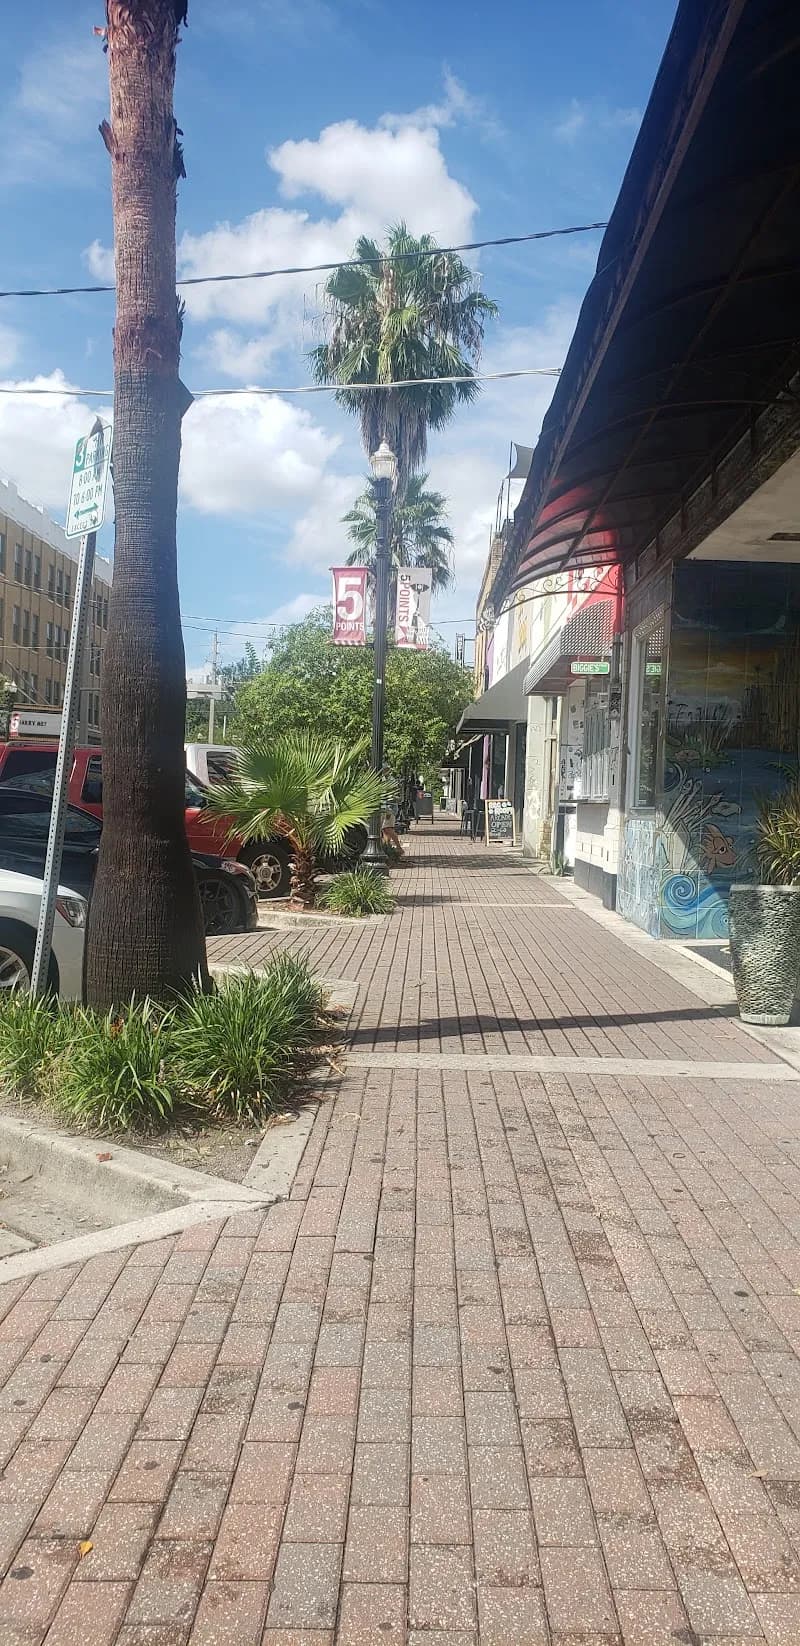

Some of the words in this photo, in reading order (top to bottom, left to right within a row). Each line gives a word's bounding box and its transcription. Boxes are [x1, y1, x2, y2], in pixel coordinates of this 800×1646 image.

[86, 444, 110, 465] PARG
[73, 492, 80, 506] TO
[95, 484, 103, 499] PM
[400, 574, 411, 582] 5
[337, 576, 363, 621] 5
[398, 583, 411, 622] POINTS
[336, 622, 364, 631] POINTS
[573, 663, 600, 673] BIGGIE'S
